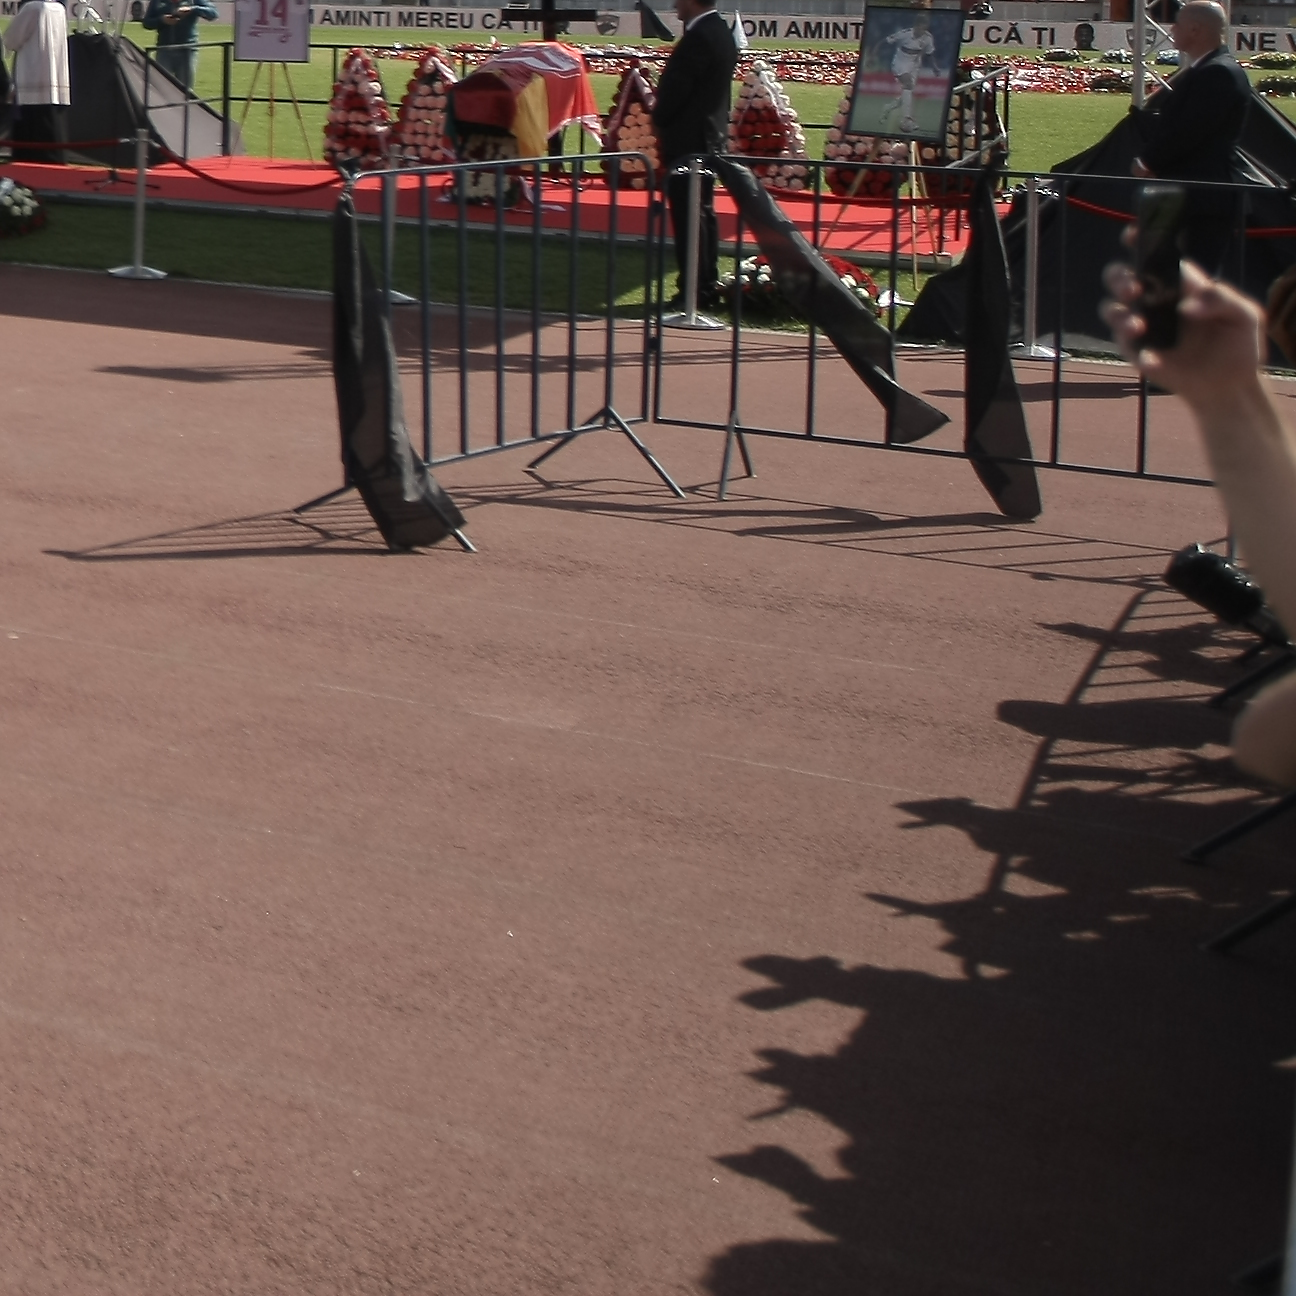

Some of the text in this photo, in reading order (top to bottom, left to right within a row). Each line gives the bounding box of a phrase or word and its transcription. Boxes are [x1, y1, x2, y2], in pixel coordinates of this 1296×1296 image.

[320, 8, 391, 26] AMINTI
[398, 10, 474, 29] MEREU
[730, 18, 777, 38] OM
[784, 20, 864, 40] AMINT
[1236, 32, 1277, 51] NE
